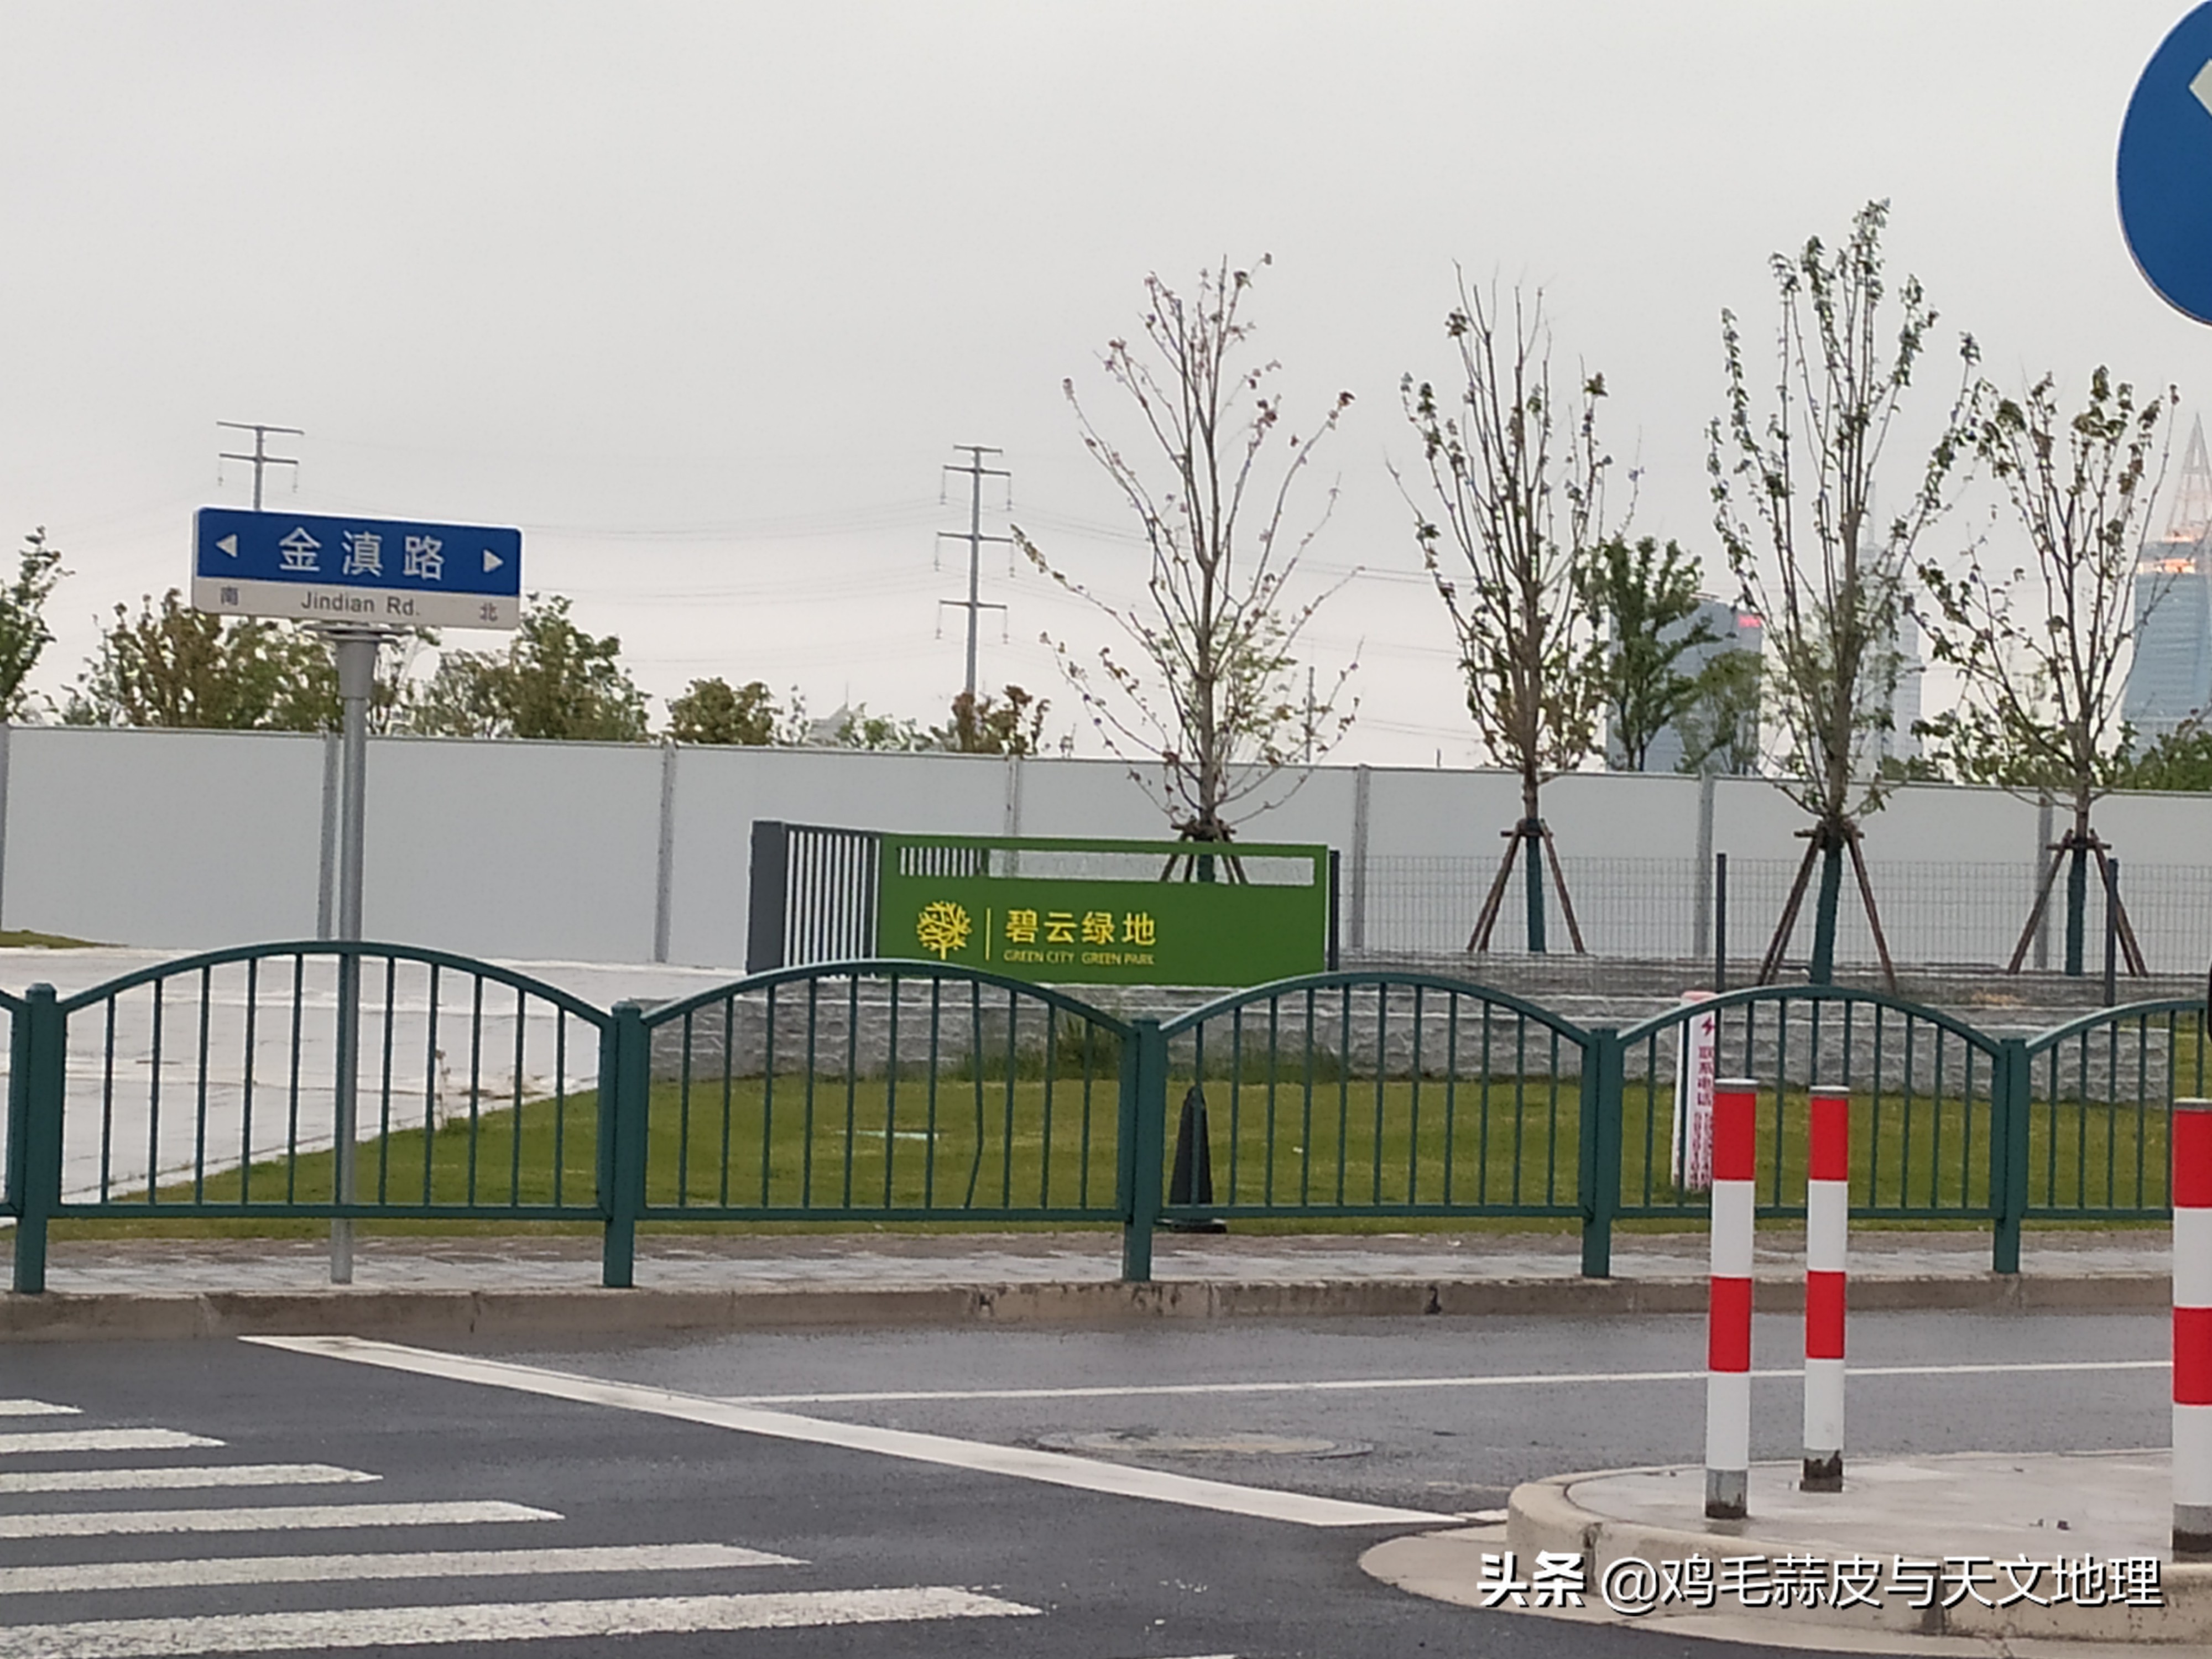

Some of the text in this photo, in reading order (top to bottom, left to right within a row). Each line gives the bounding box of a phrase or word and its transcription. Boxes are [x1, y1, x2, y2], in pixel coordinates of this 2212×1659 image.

[279, 527, 444, 581] 金滇路
[221, 586, 238, 606] 南
[301, 592, 420, 615] Jindian Rd.
[479, 603, 498, 622] 北
[1005, 909, 1156, 946] 碧云绿地
[1004, 950, 1154, 965] GREEN CITY GREEN PARK
